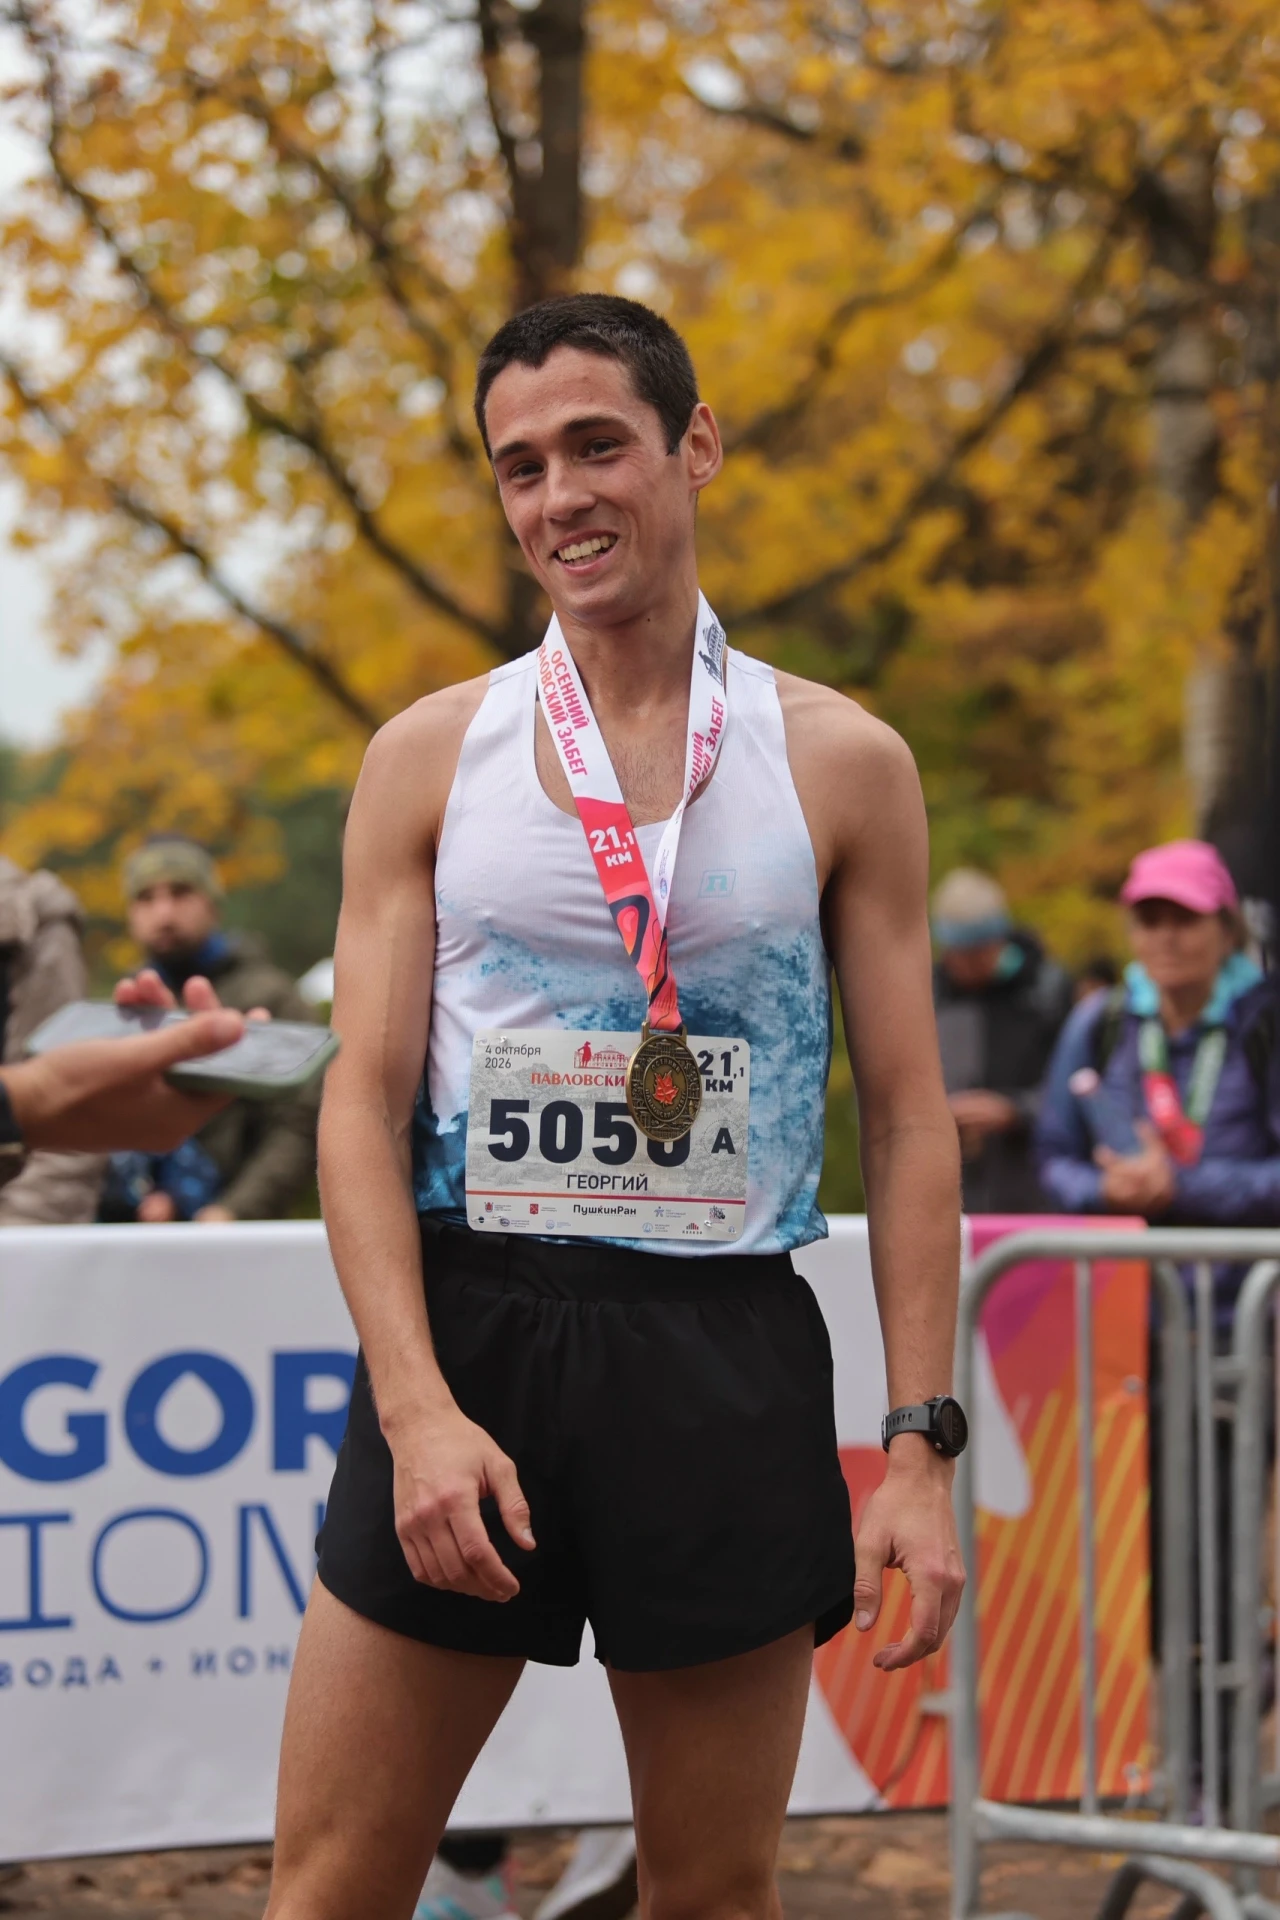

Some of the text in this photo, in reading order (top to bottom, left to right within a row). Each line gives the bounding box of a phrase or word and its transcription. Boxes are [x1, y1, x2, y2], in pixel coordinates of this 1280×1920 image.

[551, 649, 590, 730] ОСЕННИЙ
[537, 643, 588, 776] ВЛОВСКИЙ ЗАБЕГ
[705, 696, 724, 752] ЗАБЕГ
[687, 731, 705, 798] ЕННИЙ
[589, 825, 635, 854] 21,1
[485, 1044, 541, 1058] 4 октября
[485, 1057, 512, 1069] 2026
[697, 1050, 744, 1079] 21,1
[531, 1072, 625, 1087] ПАВЛОВСКИ
[566, 1173, 648, 1191] ГЕОРГИЙ
